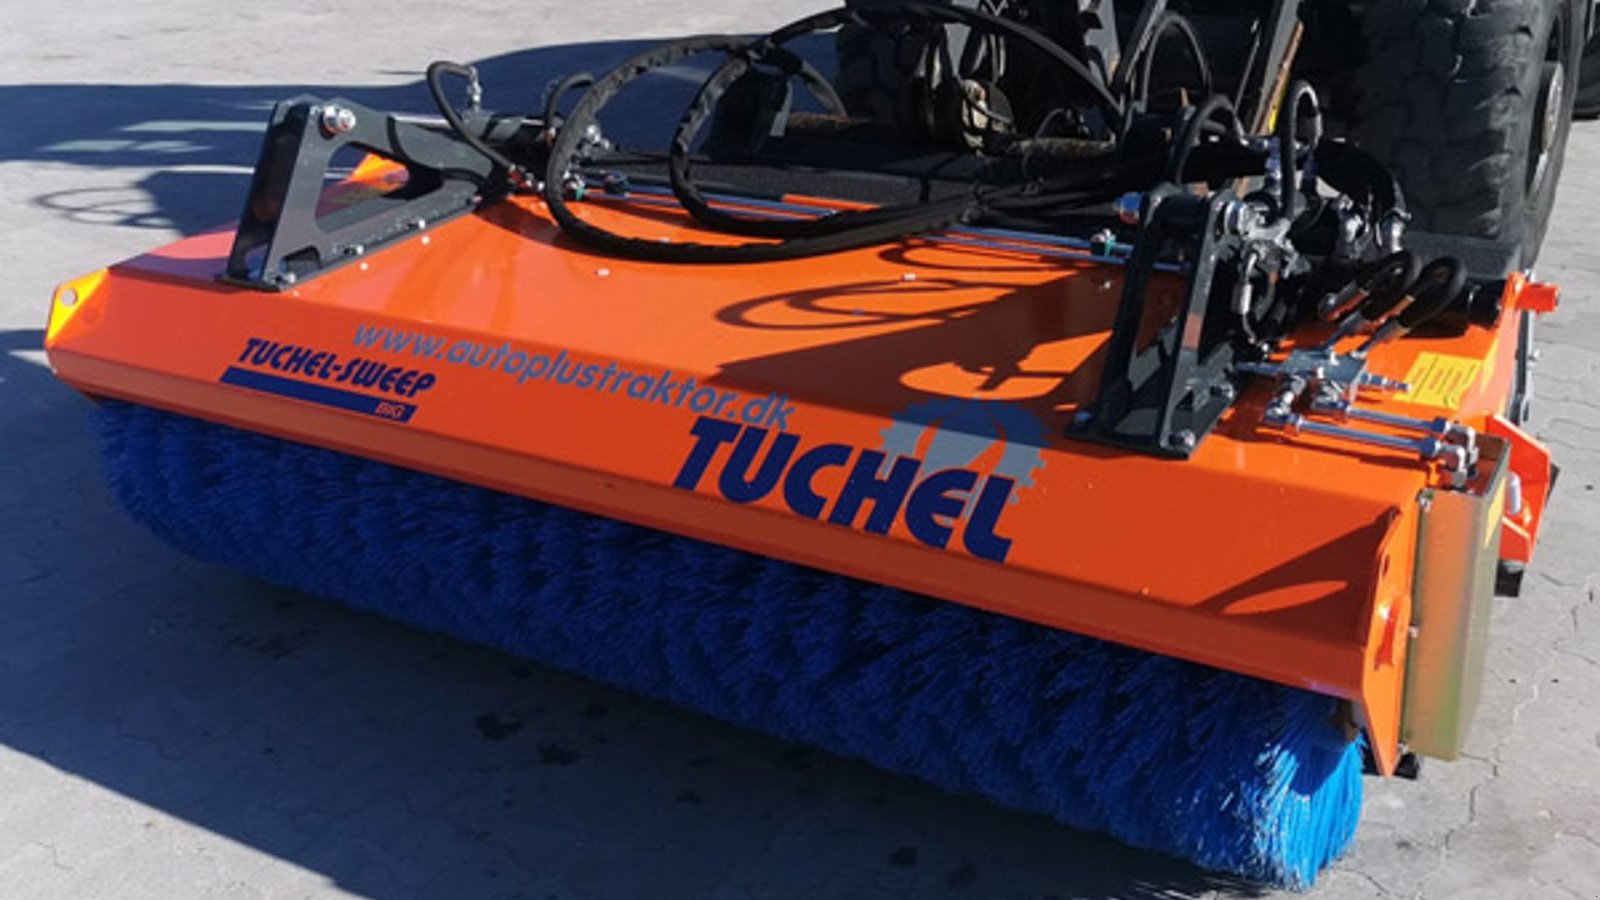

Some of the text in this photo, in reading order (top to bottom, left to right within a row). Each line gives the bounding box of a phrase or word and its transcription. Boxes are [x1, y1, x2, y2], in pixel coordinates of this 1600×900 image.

[238, 338, 436, 398] TUCHEL-SWEEP
[353, 323, 795, 430] www.autoplustraktor.dk
[672, 415, 1015, 563] TUCHEL
